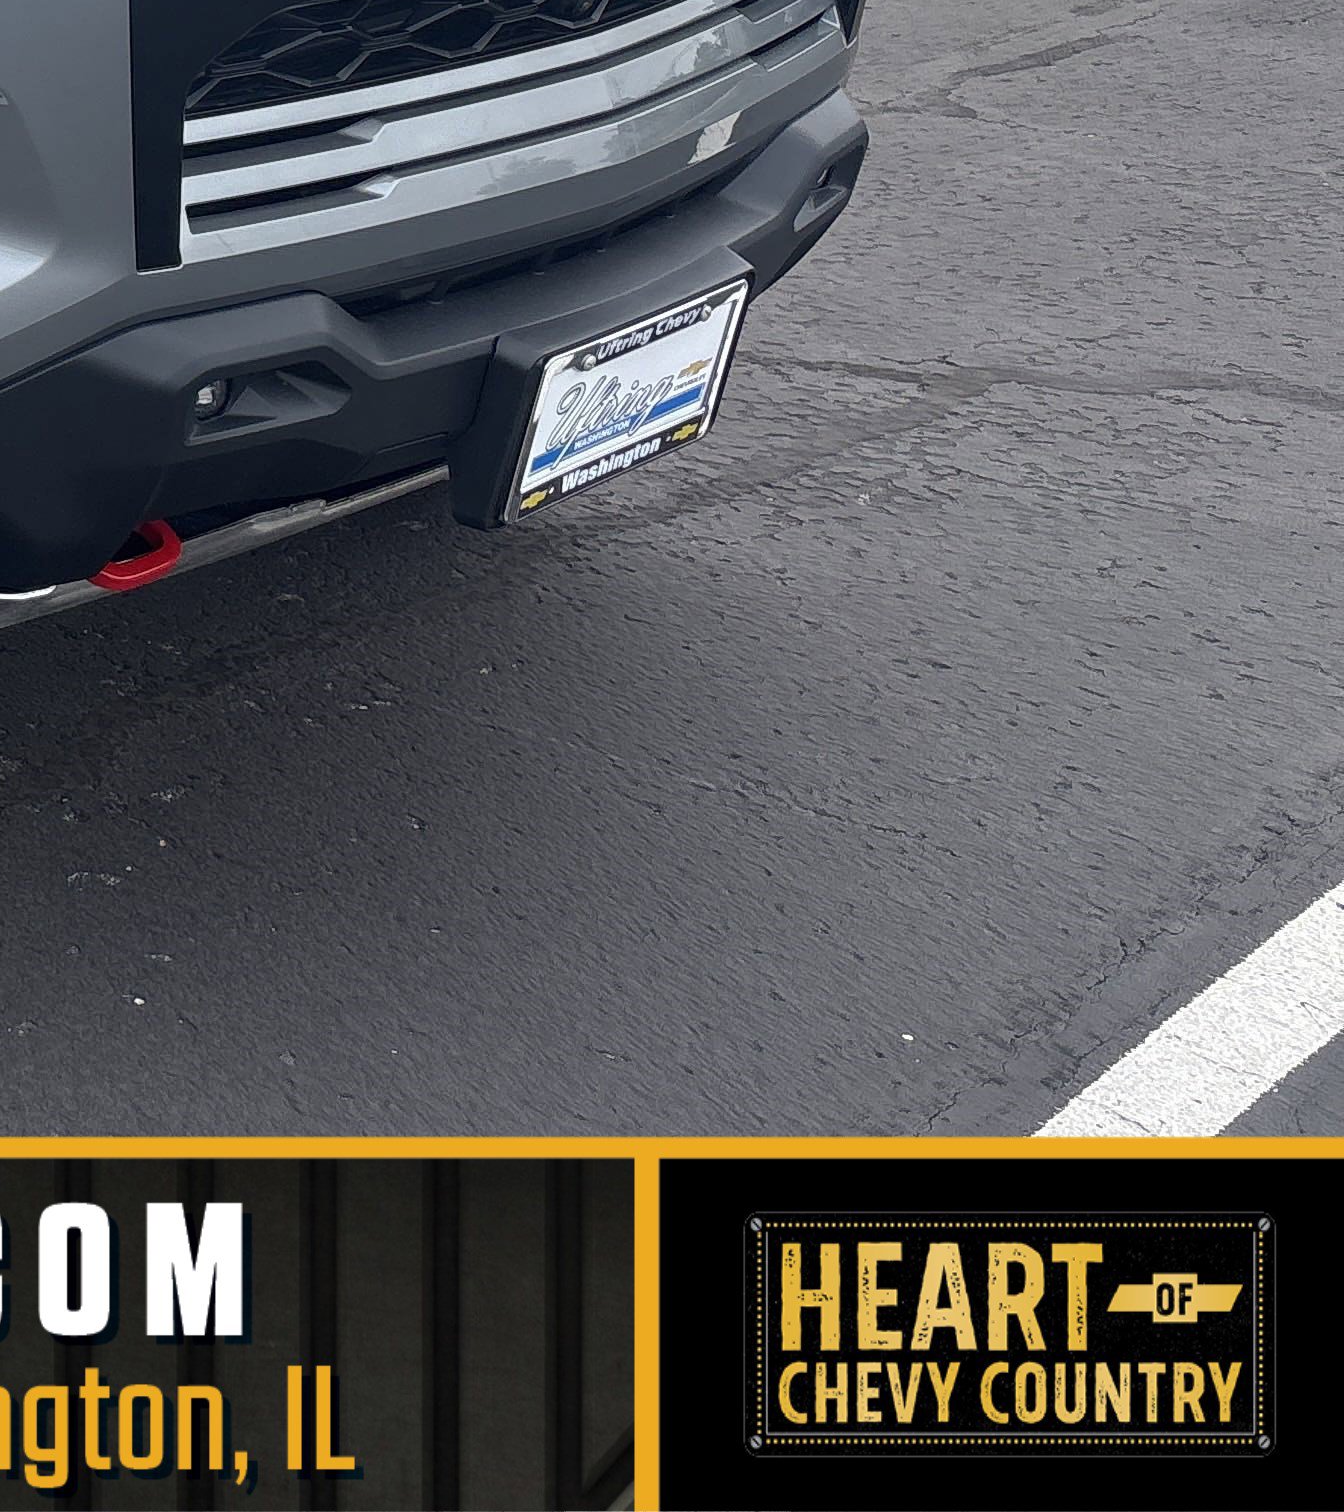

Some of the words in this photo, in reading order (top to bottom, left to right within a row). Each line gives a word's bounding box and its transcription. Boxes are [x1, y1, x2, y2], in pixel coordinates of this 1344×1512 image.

[597, 326, 651, 360] Uftring
[655, 307, 702, 335] Chevy
[546, 374, 674, 470] Uftring
[573, 419, 631, 450] WASHINGTON
[561, 436, 661, 493] Washington
